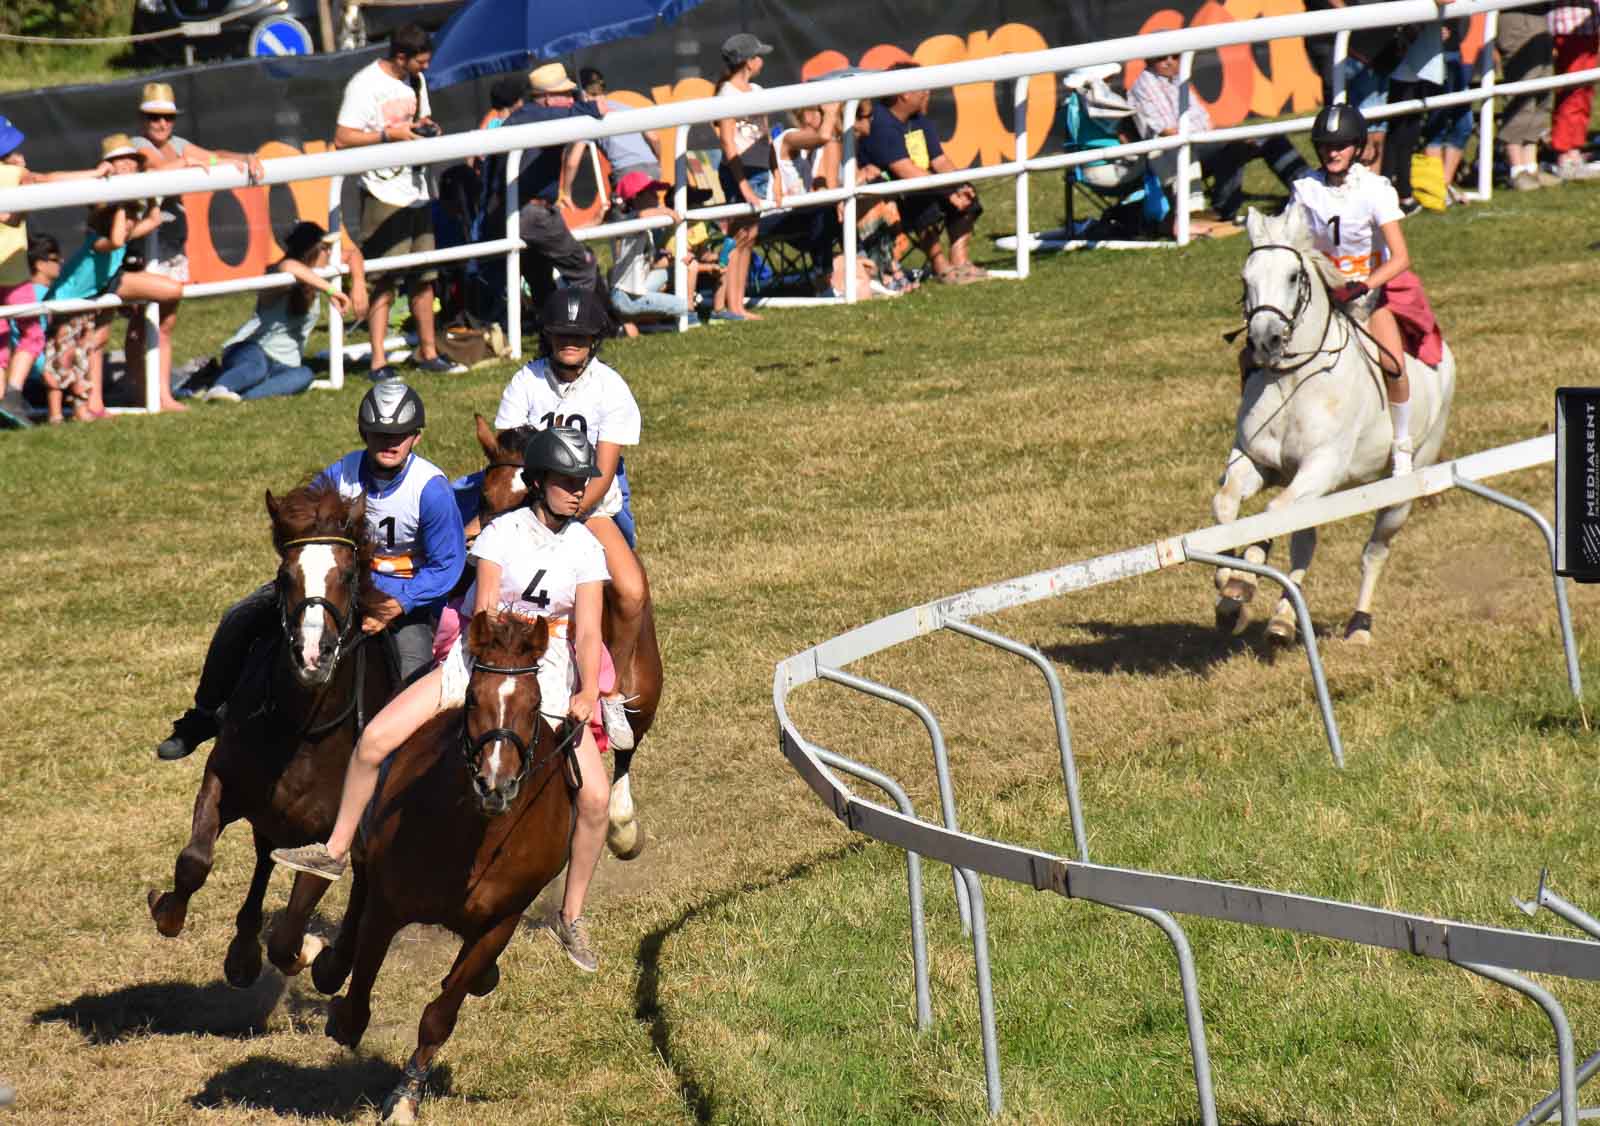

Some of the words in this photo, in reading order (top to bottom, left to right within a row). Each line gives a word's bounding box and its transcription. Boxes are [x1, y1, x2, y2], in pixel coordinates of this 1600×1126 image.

[801, 23, 1056, 168] op
[1328, 215, 1340, 246] 1
[1586, 402, 1596, 517] MEDIARENT
[378, 516, 396, 549] 1
[521, 569, 551, 609] 4
